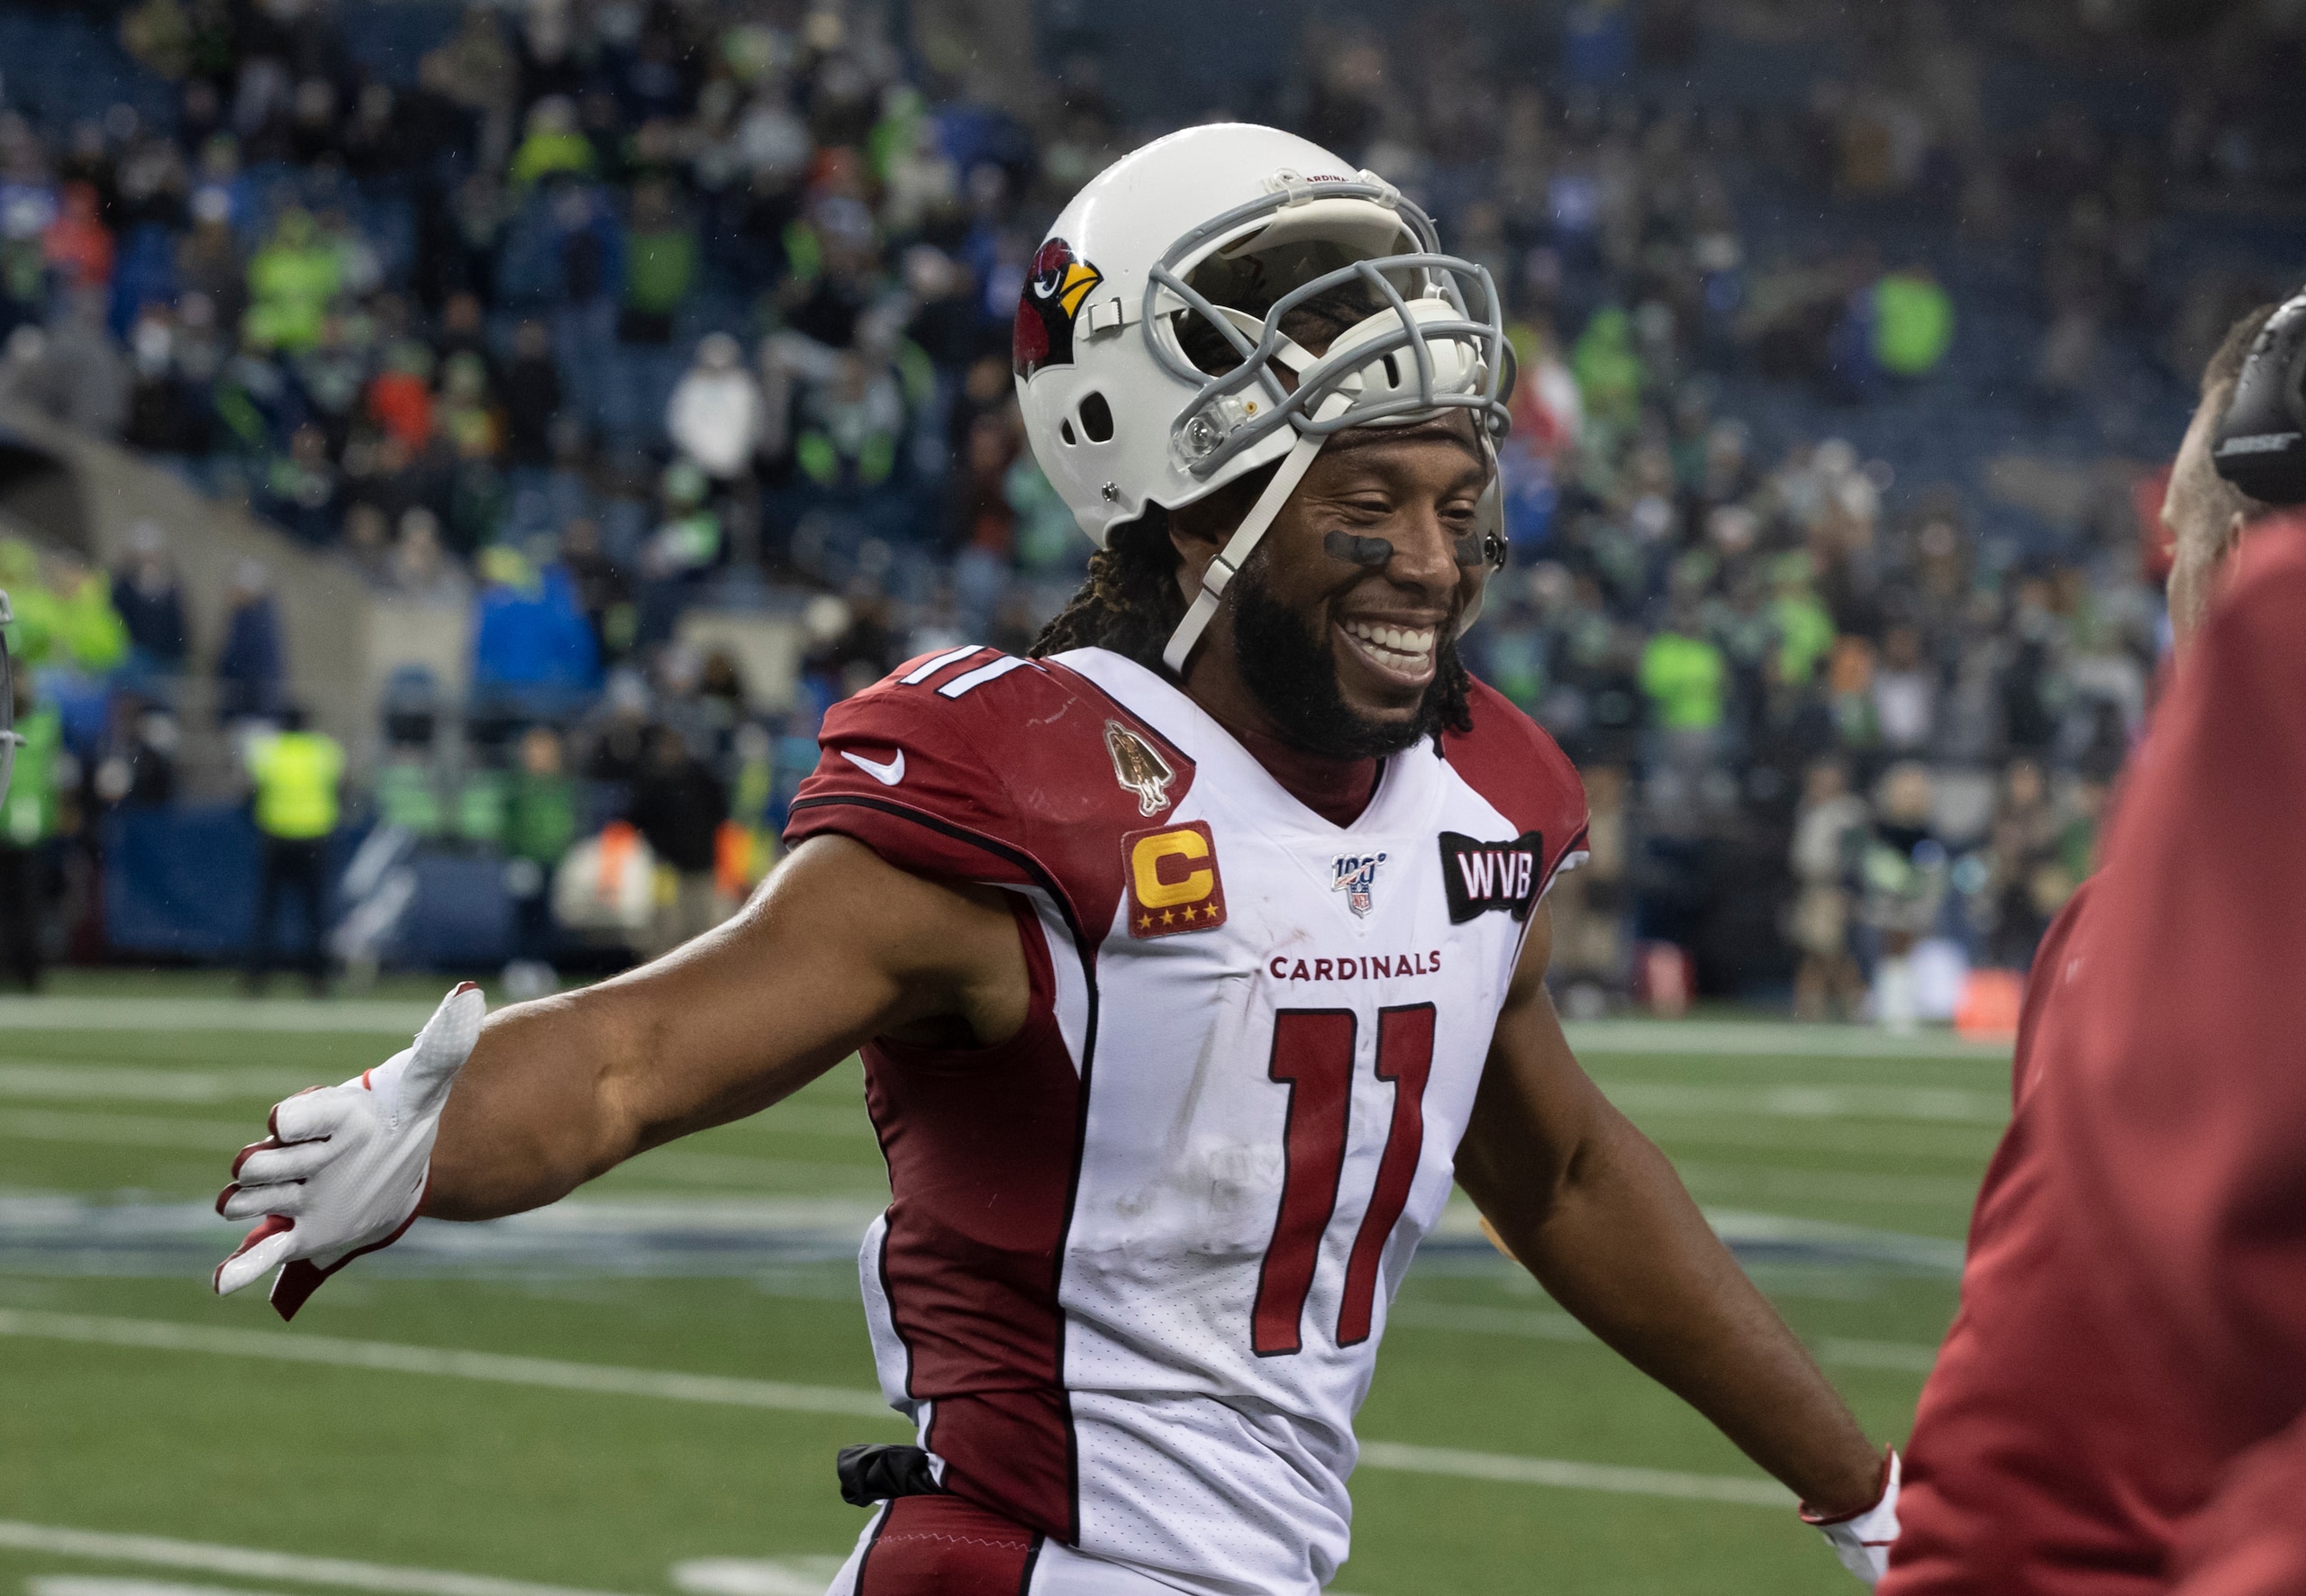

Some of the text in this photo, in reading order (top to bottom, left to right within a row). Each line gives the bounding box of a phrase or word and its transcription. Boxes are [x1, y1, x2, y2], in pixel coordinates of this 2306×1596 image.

[1131, 830, 1214, 909] C
[1457, 849, 1533, 901] WVB
[1269, 950, 1441, 982] CARDINALS
[1250, 1002, 1437, 1358] 11
